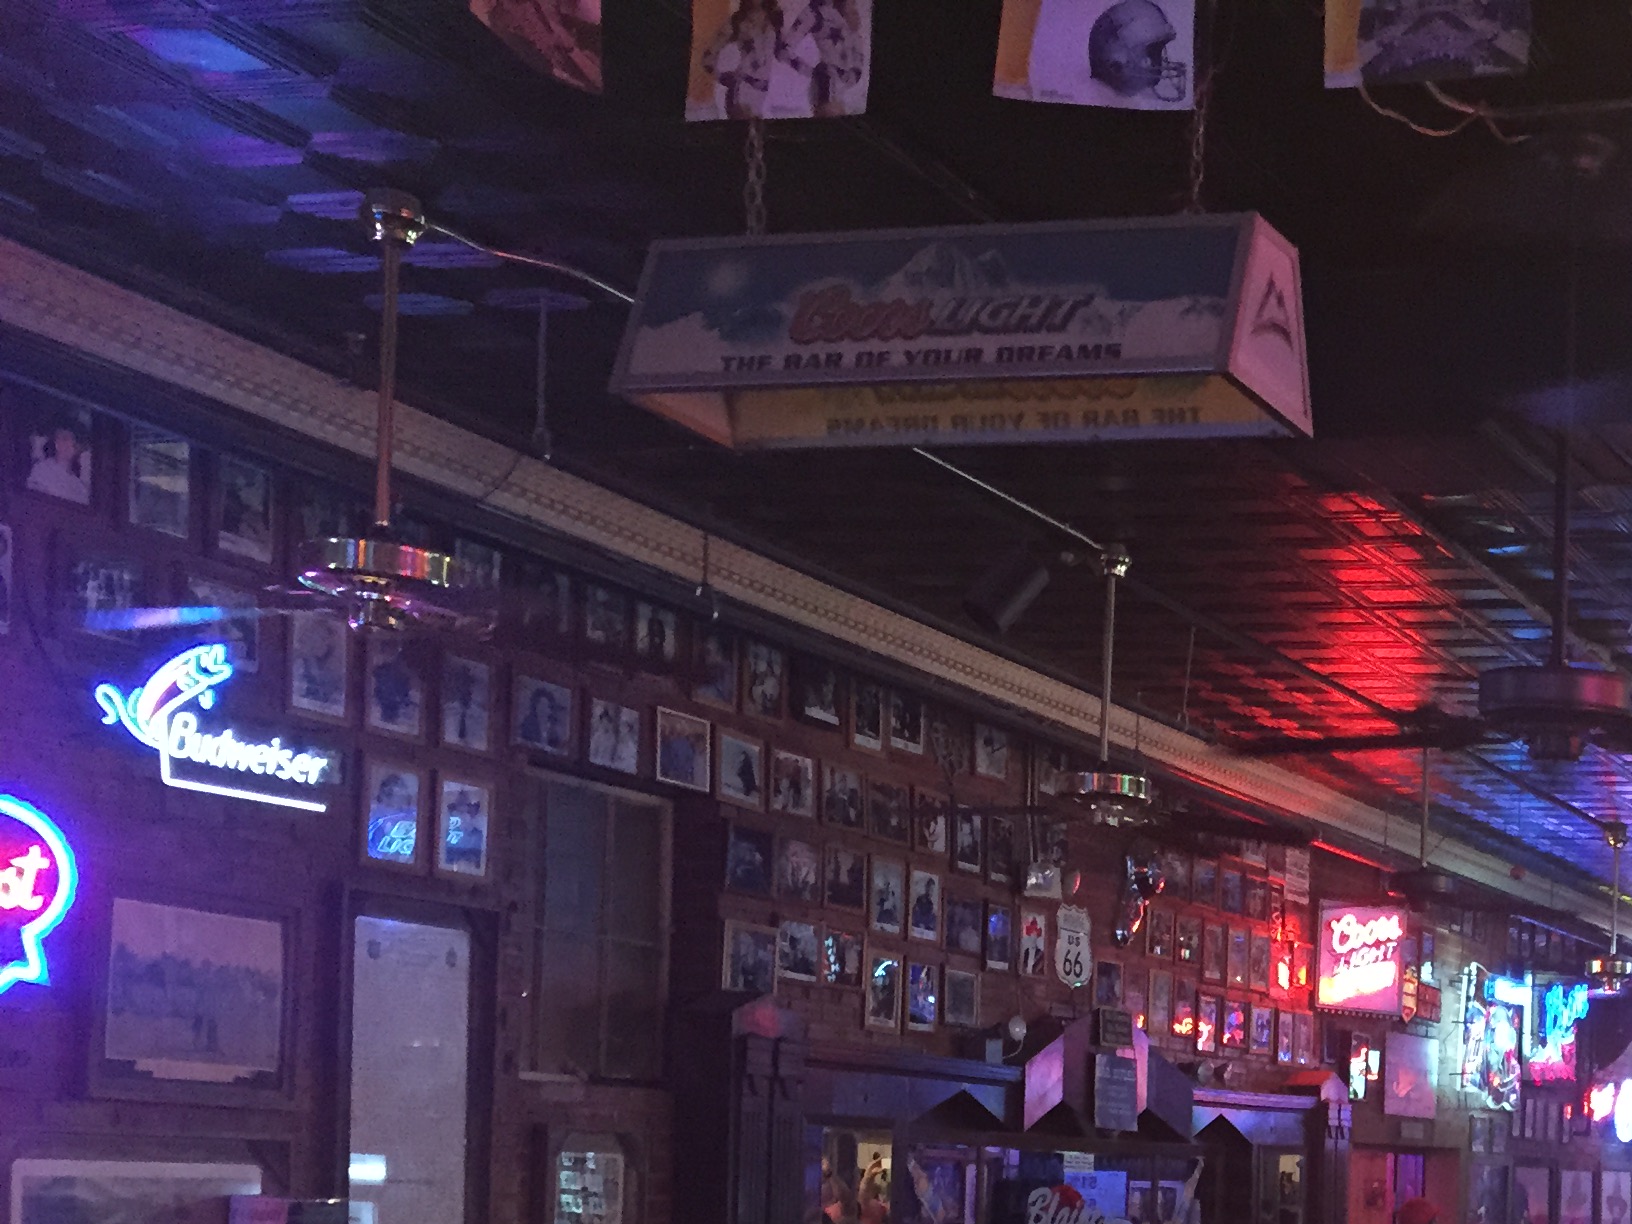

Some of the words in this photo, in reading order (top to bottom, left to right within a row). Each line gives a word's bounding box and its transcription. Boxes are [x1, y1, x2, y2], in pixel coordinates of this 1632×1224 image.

[928, 295, 1094, 336] LIGHT
[720, 355, 776, 374] THE
[783, 351, 842, 372] BAR
[855, 350, 892, 368] OF
[905, 346, 985, 367] YOUR
[994, 342, 1123, 362] DREAMS
[168, 711, 328, 786] Budweiser
[1062, 949, 1083, 979] 66
